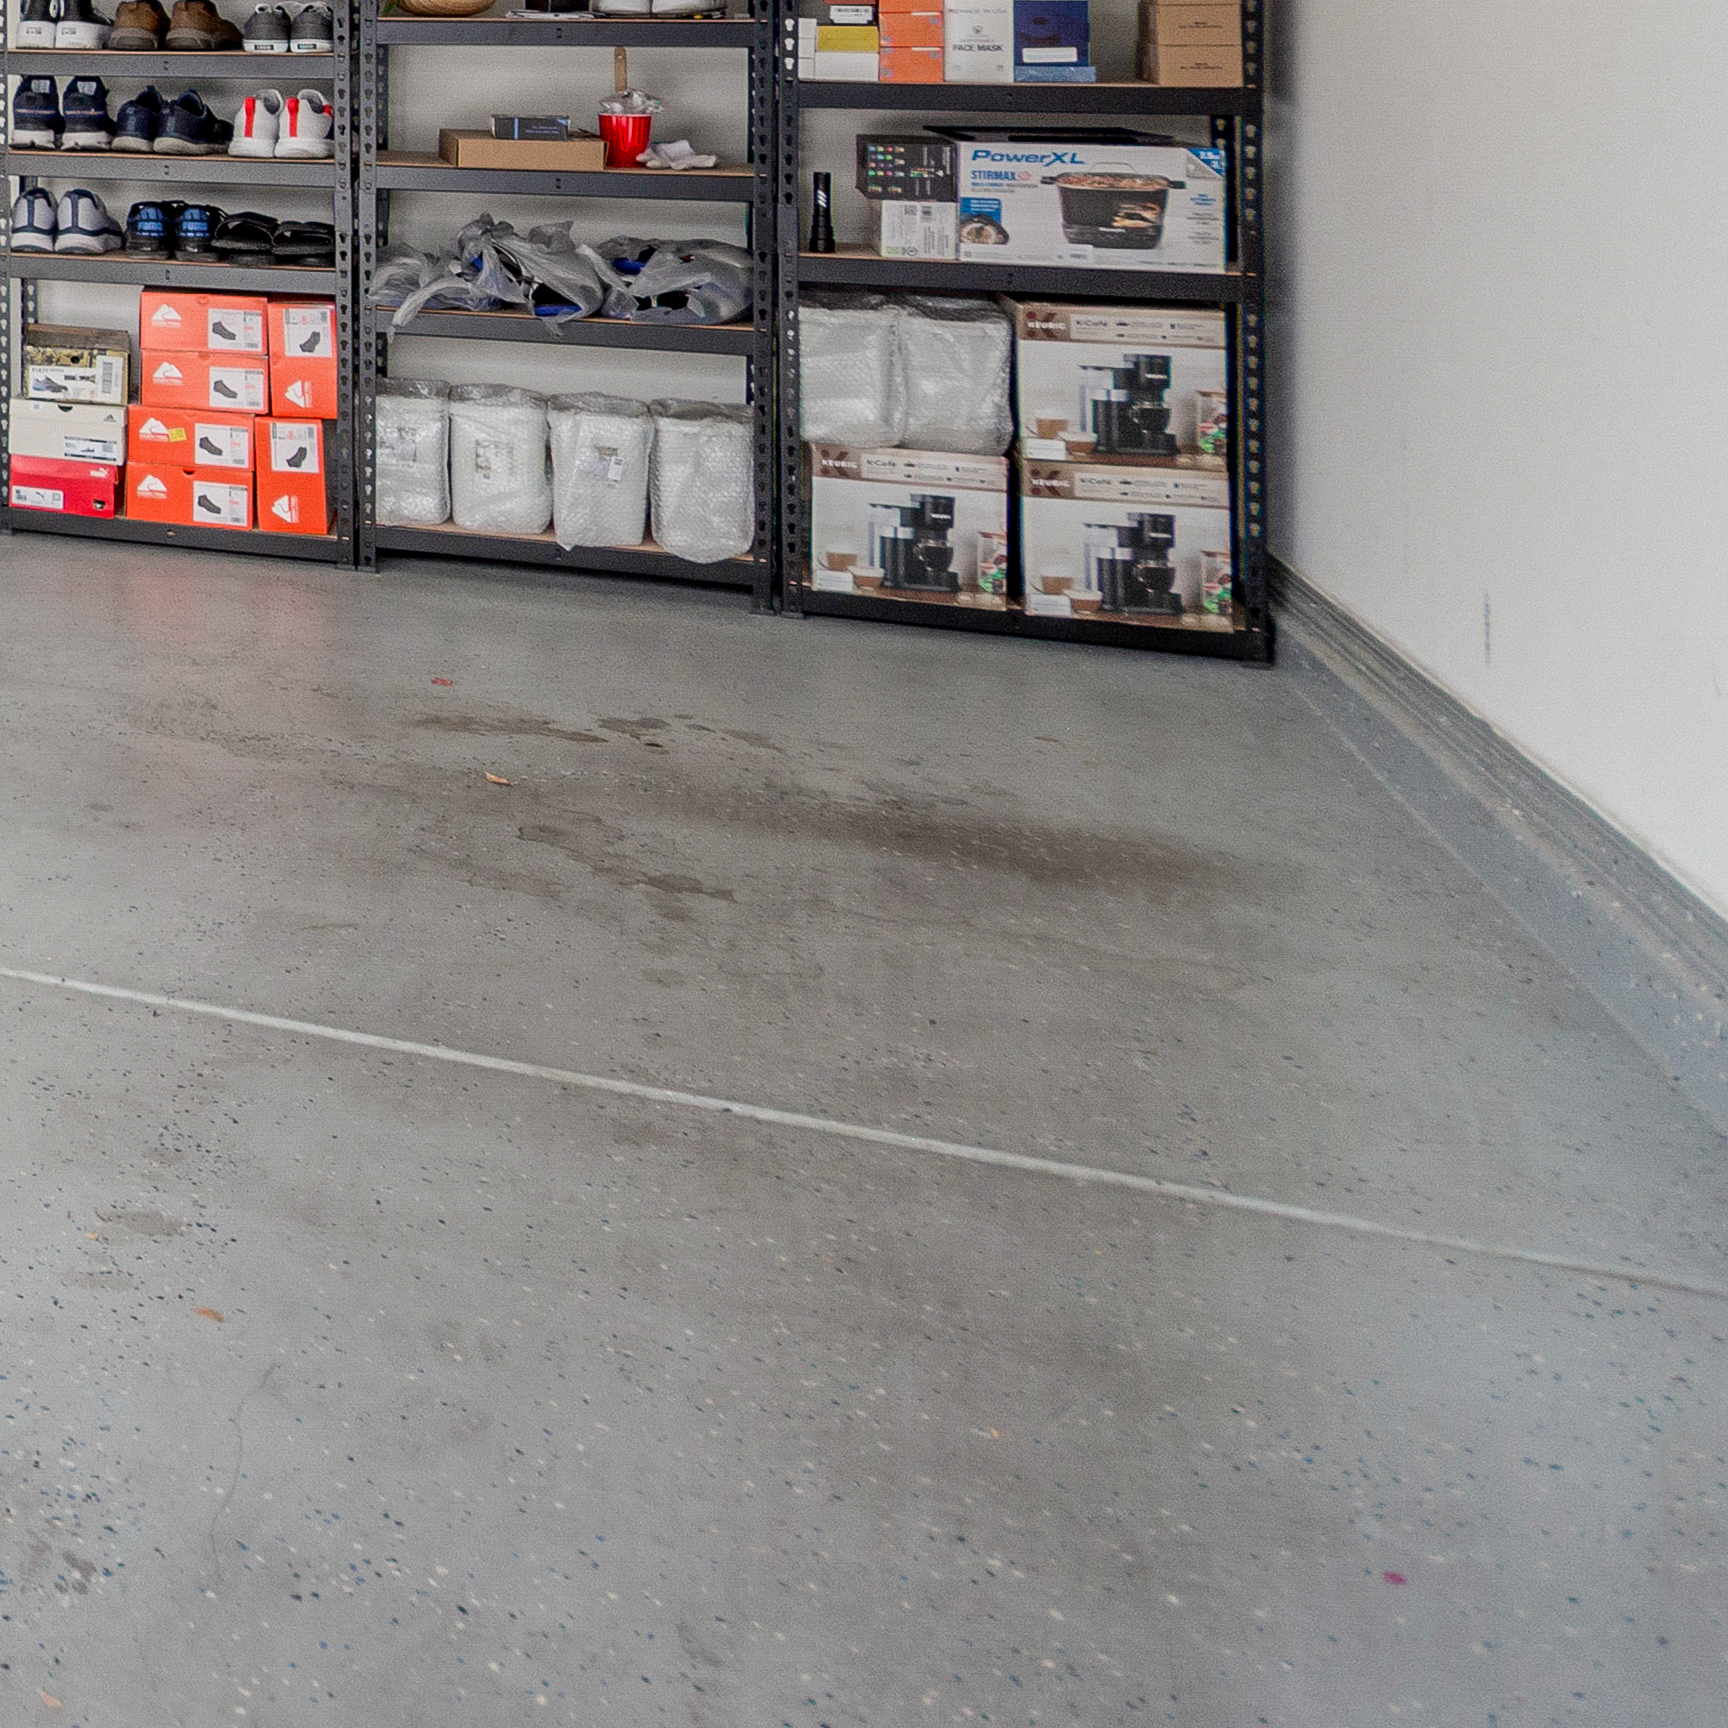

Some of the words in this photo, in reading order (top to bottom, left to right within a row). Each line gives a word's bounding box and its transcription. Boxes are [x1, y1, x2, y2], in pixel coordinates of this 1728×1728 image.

[952, 43, 975, 52] FACE
[977, 43, 1004, 52] MASK
[971, 149, 1086, 167] PowerXL
[971, 170, 1017, 181] STIRMAX
[1025, 322, 1067, 330] KEURIG
[821, 458, 859, 469] KEURIG
